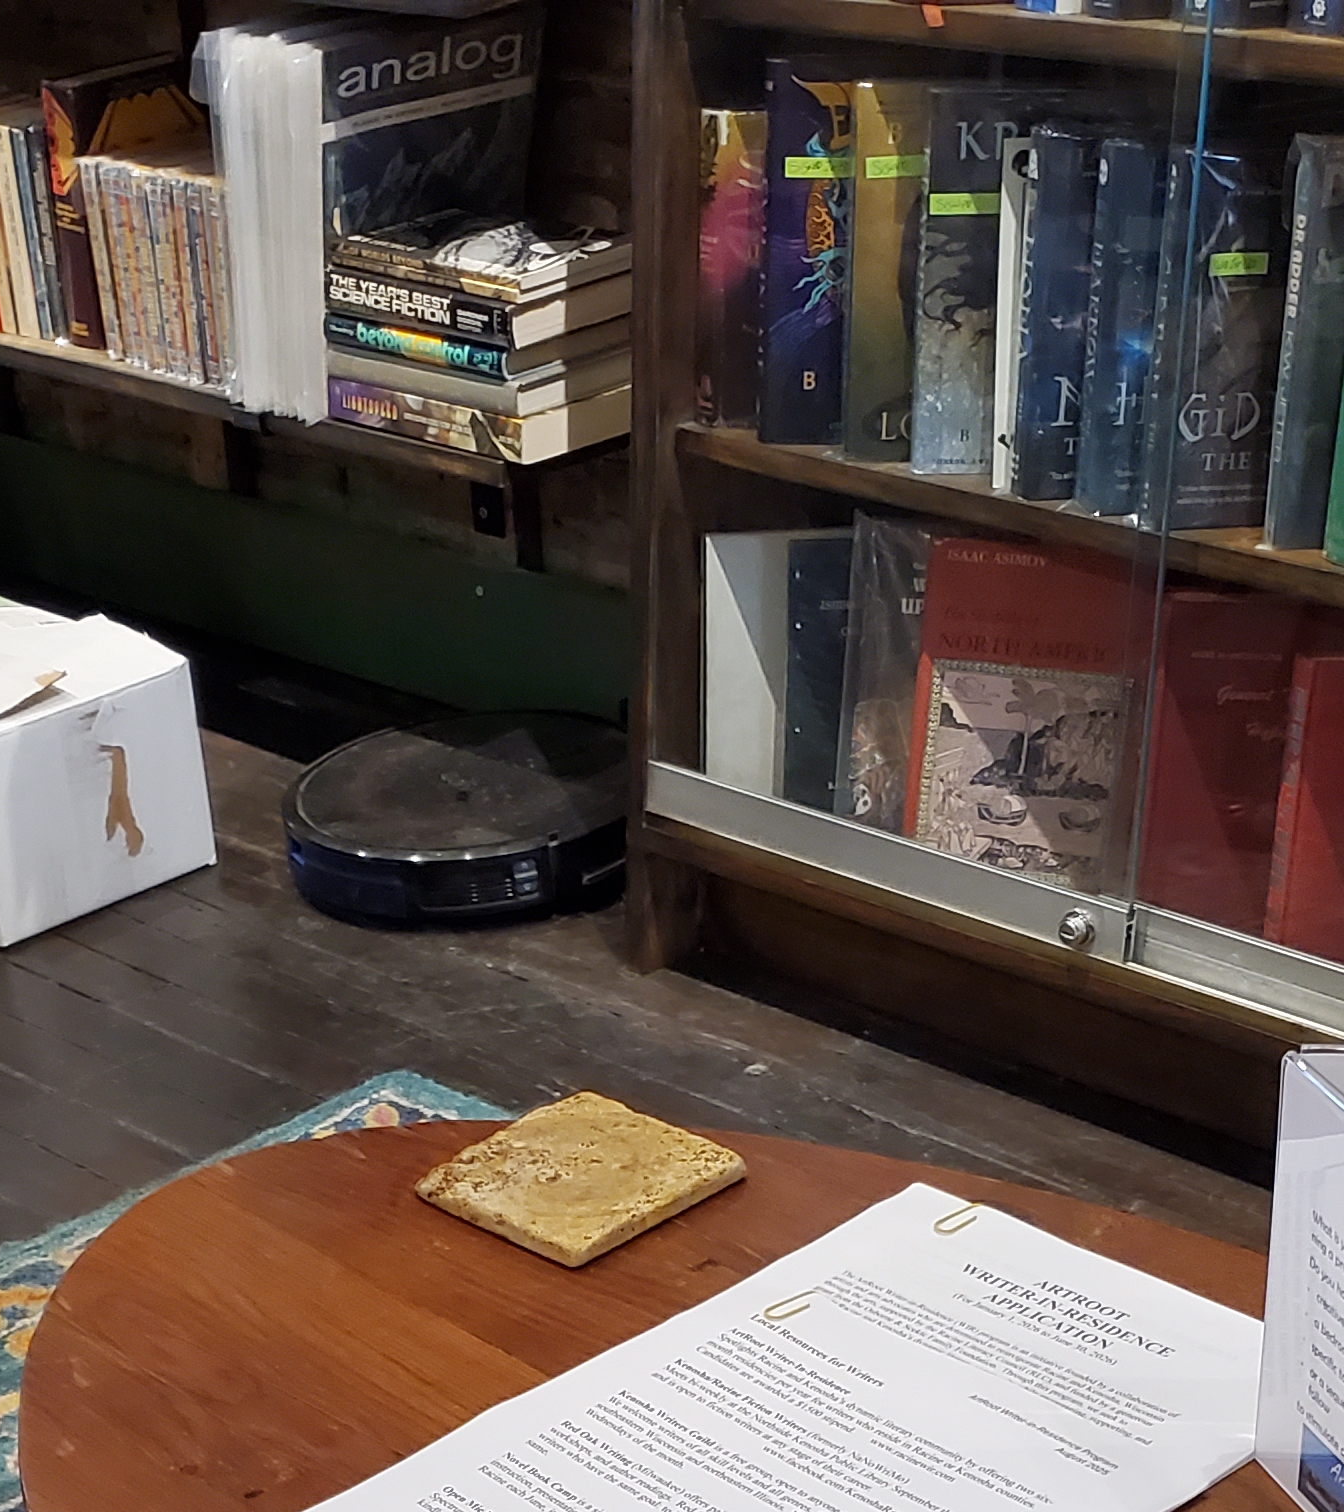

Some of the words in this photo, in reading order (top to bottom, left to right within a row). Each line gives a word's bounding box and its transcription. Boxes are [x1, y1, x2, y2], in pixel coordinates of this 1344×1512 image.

[337, 33, 524, 99] analog
[328, 287, 392, 314] SCIENCE
[391, 301, 452, 326] FICTION
[330, 273, 357, 291] THE
[359, 278, 410, 301] YEAR'S
[412, 292, 452, 312] BEST
[1287, 249, 1304, 319] ADDER
[356, 322, 412, 354] beyond
[946, 548, 988, 564] ISAAC
[992, 553, 1048, 568] ASIMOV
[961, 1262, 1176, 1358] WRITER-IN-RESIDENCE
[981, 1293, 1114, 1350] APPLICATION
[1031, 1279, 1131, 1321] ARTROOT
[748, 1312, 782, 1332] Local
[776, 1327, 829, 1360] Resources
[826, 1356, 847, 1368] for
[845, 1364, 885, 1387] Writers
